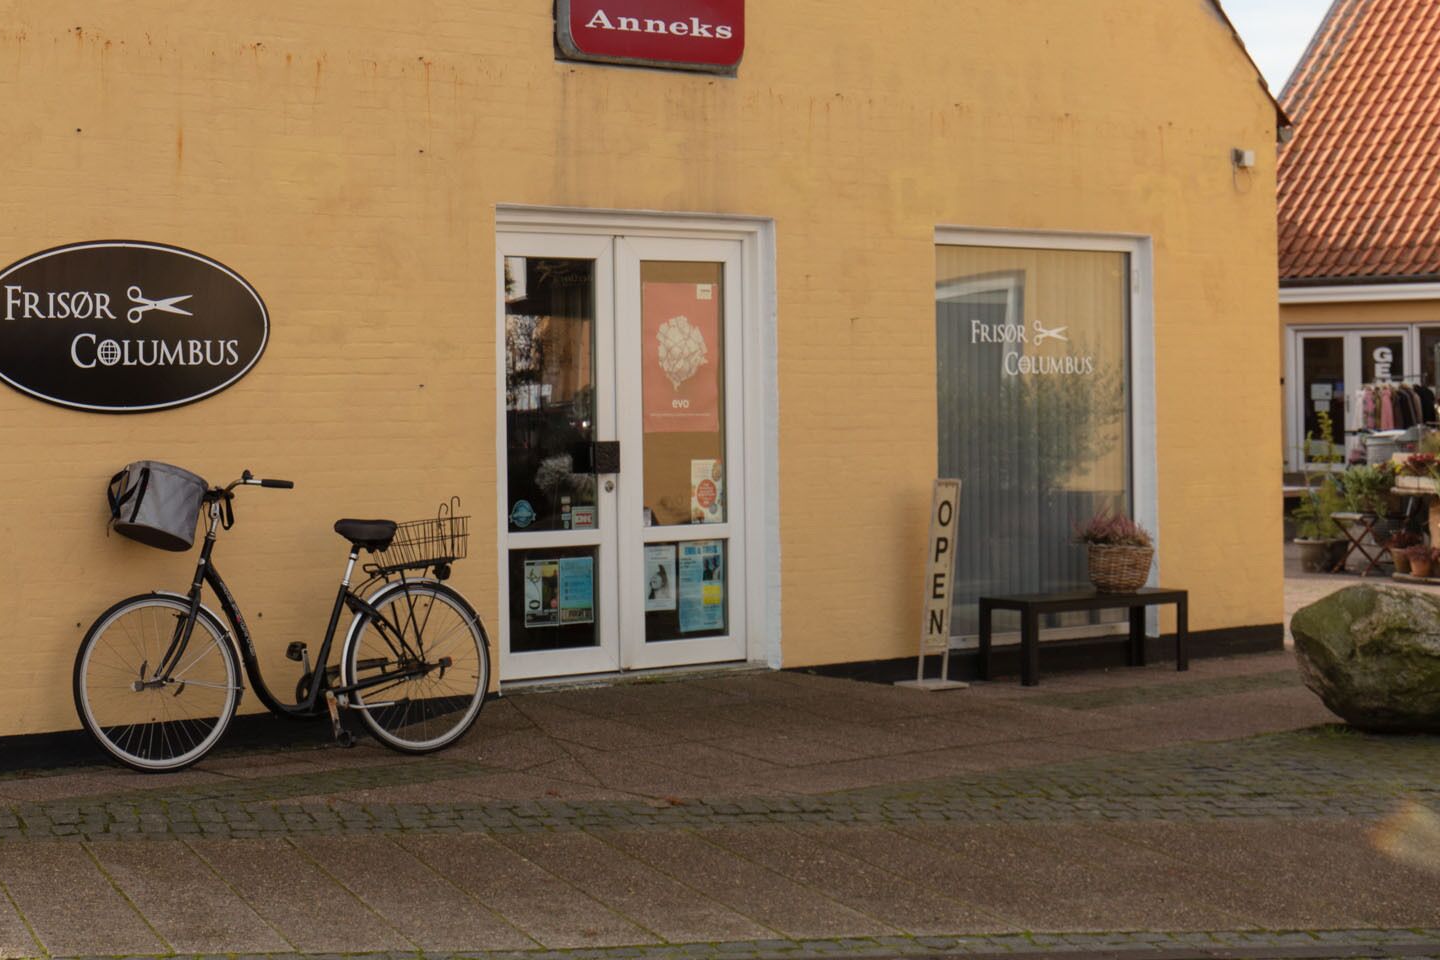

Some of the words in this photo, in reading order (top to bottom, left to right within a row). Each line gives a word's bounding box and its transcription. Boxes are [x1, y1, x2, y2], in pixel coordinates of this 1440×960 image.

[584, 9, 733, 39] Anneks
[4, 285, 117, 321] FRISØR
[70, 333, 239, 368] COLUMBUS
[1004, 351, 1093, 376] COLUMBUS
[929, 499, 953, 636] OPEN
